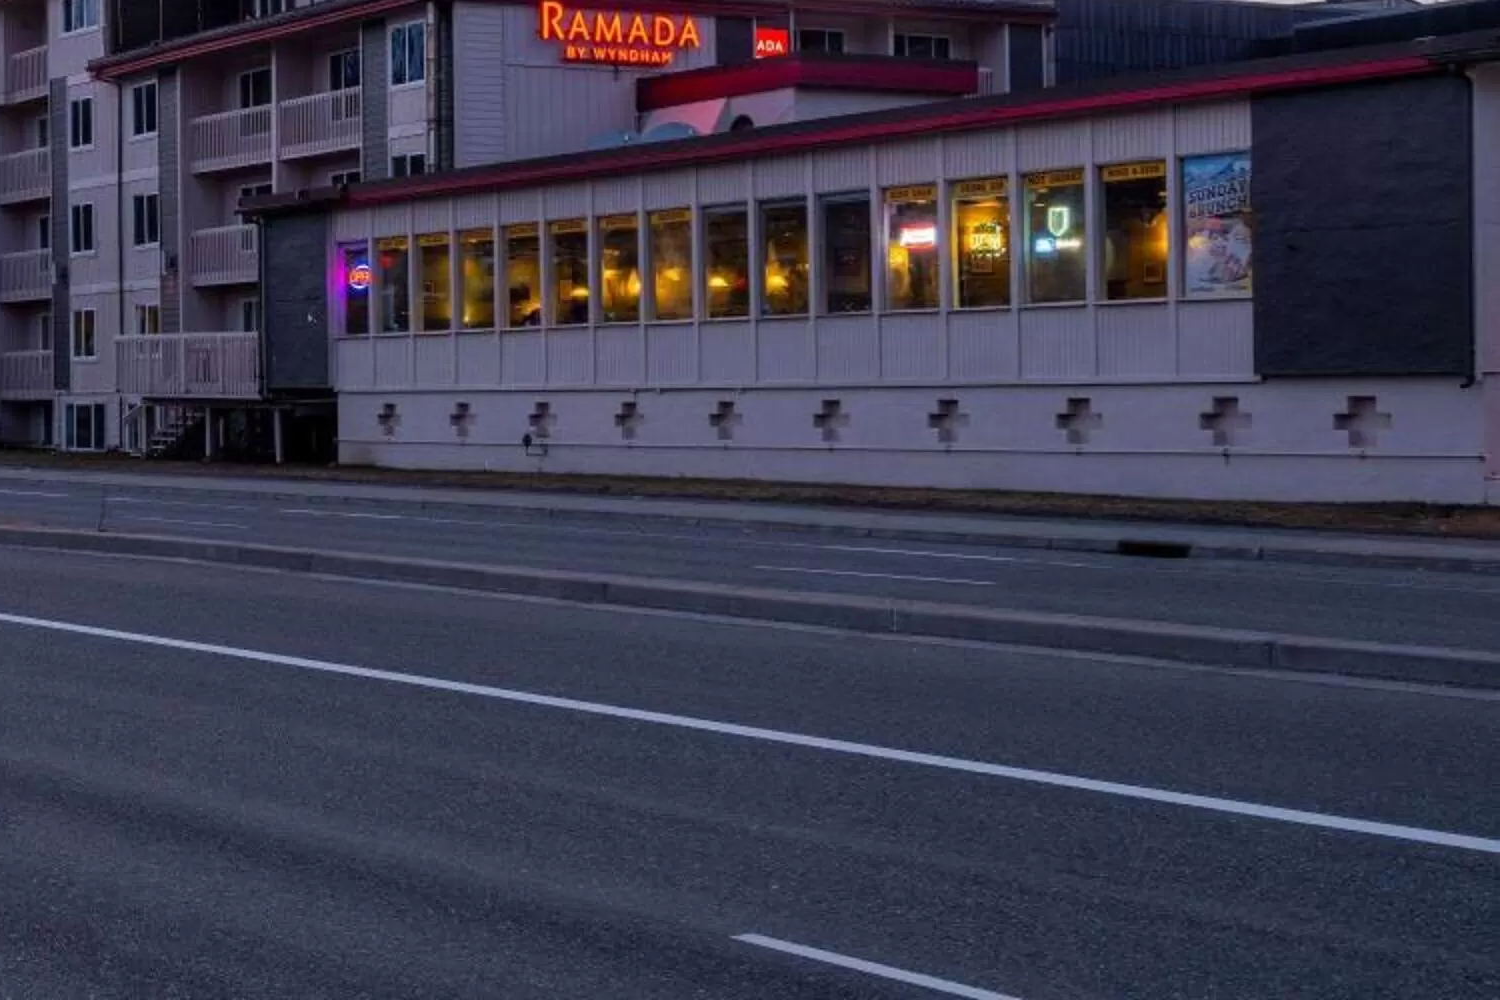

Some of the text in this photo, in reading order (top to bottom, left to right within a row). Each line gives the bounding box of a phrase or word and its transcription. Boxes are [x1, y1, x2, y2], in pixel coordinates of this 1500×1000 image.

[540, 1, 701, 48] RAMADA
[565, 45, 673, 64] BY WYNDHAM
[1188, 179, 1248, 204] SUNDAY
